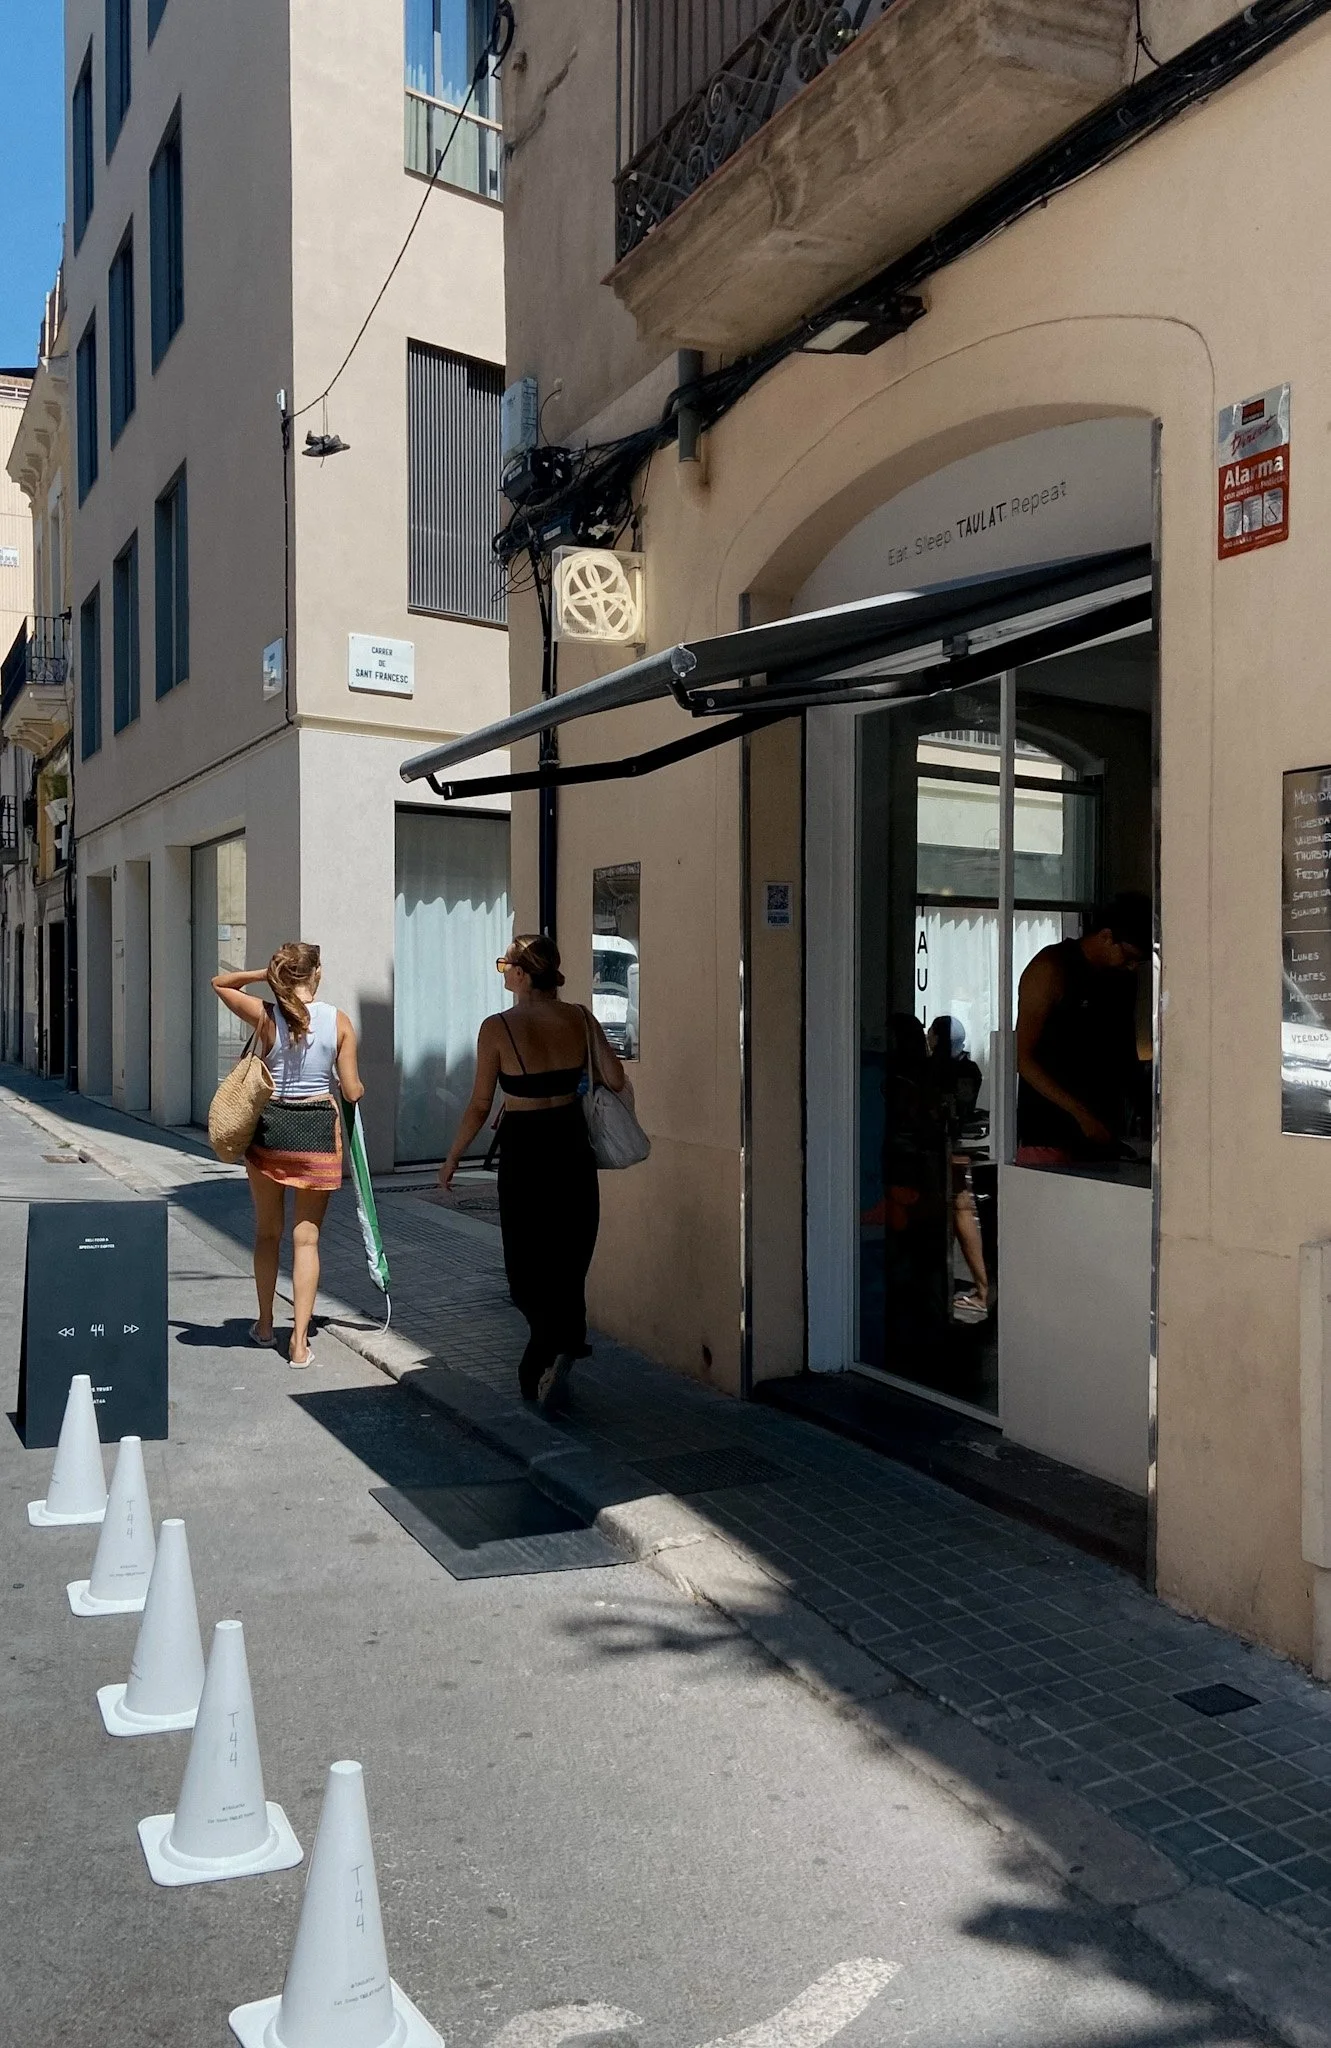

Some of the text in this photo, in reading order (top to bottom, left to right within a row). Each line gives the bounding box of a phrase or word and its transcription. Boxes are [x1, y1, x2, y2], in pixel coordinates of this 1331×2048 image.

[1224, 455, 1283, 490] Alarma
[1011, 481, 1067, 516] Repeat
[371, 646, 393, 656] CARRER
[378, 659, 386, 667] DE
[355, 668, 409, 683] SANT FRANCESC
[1291, 948, 1320, 962] LUNES
[1289, 971, 1326, 983] MARTES
[1291, 1033, 1329, 1044] VIERNES
[90, 1323, 104, 1337] 44
